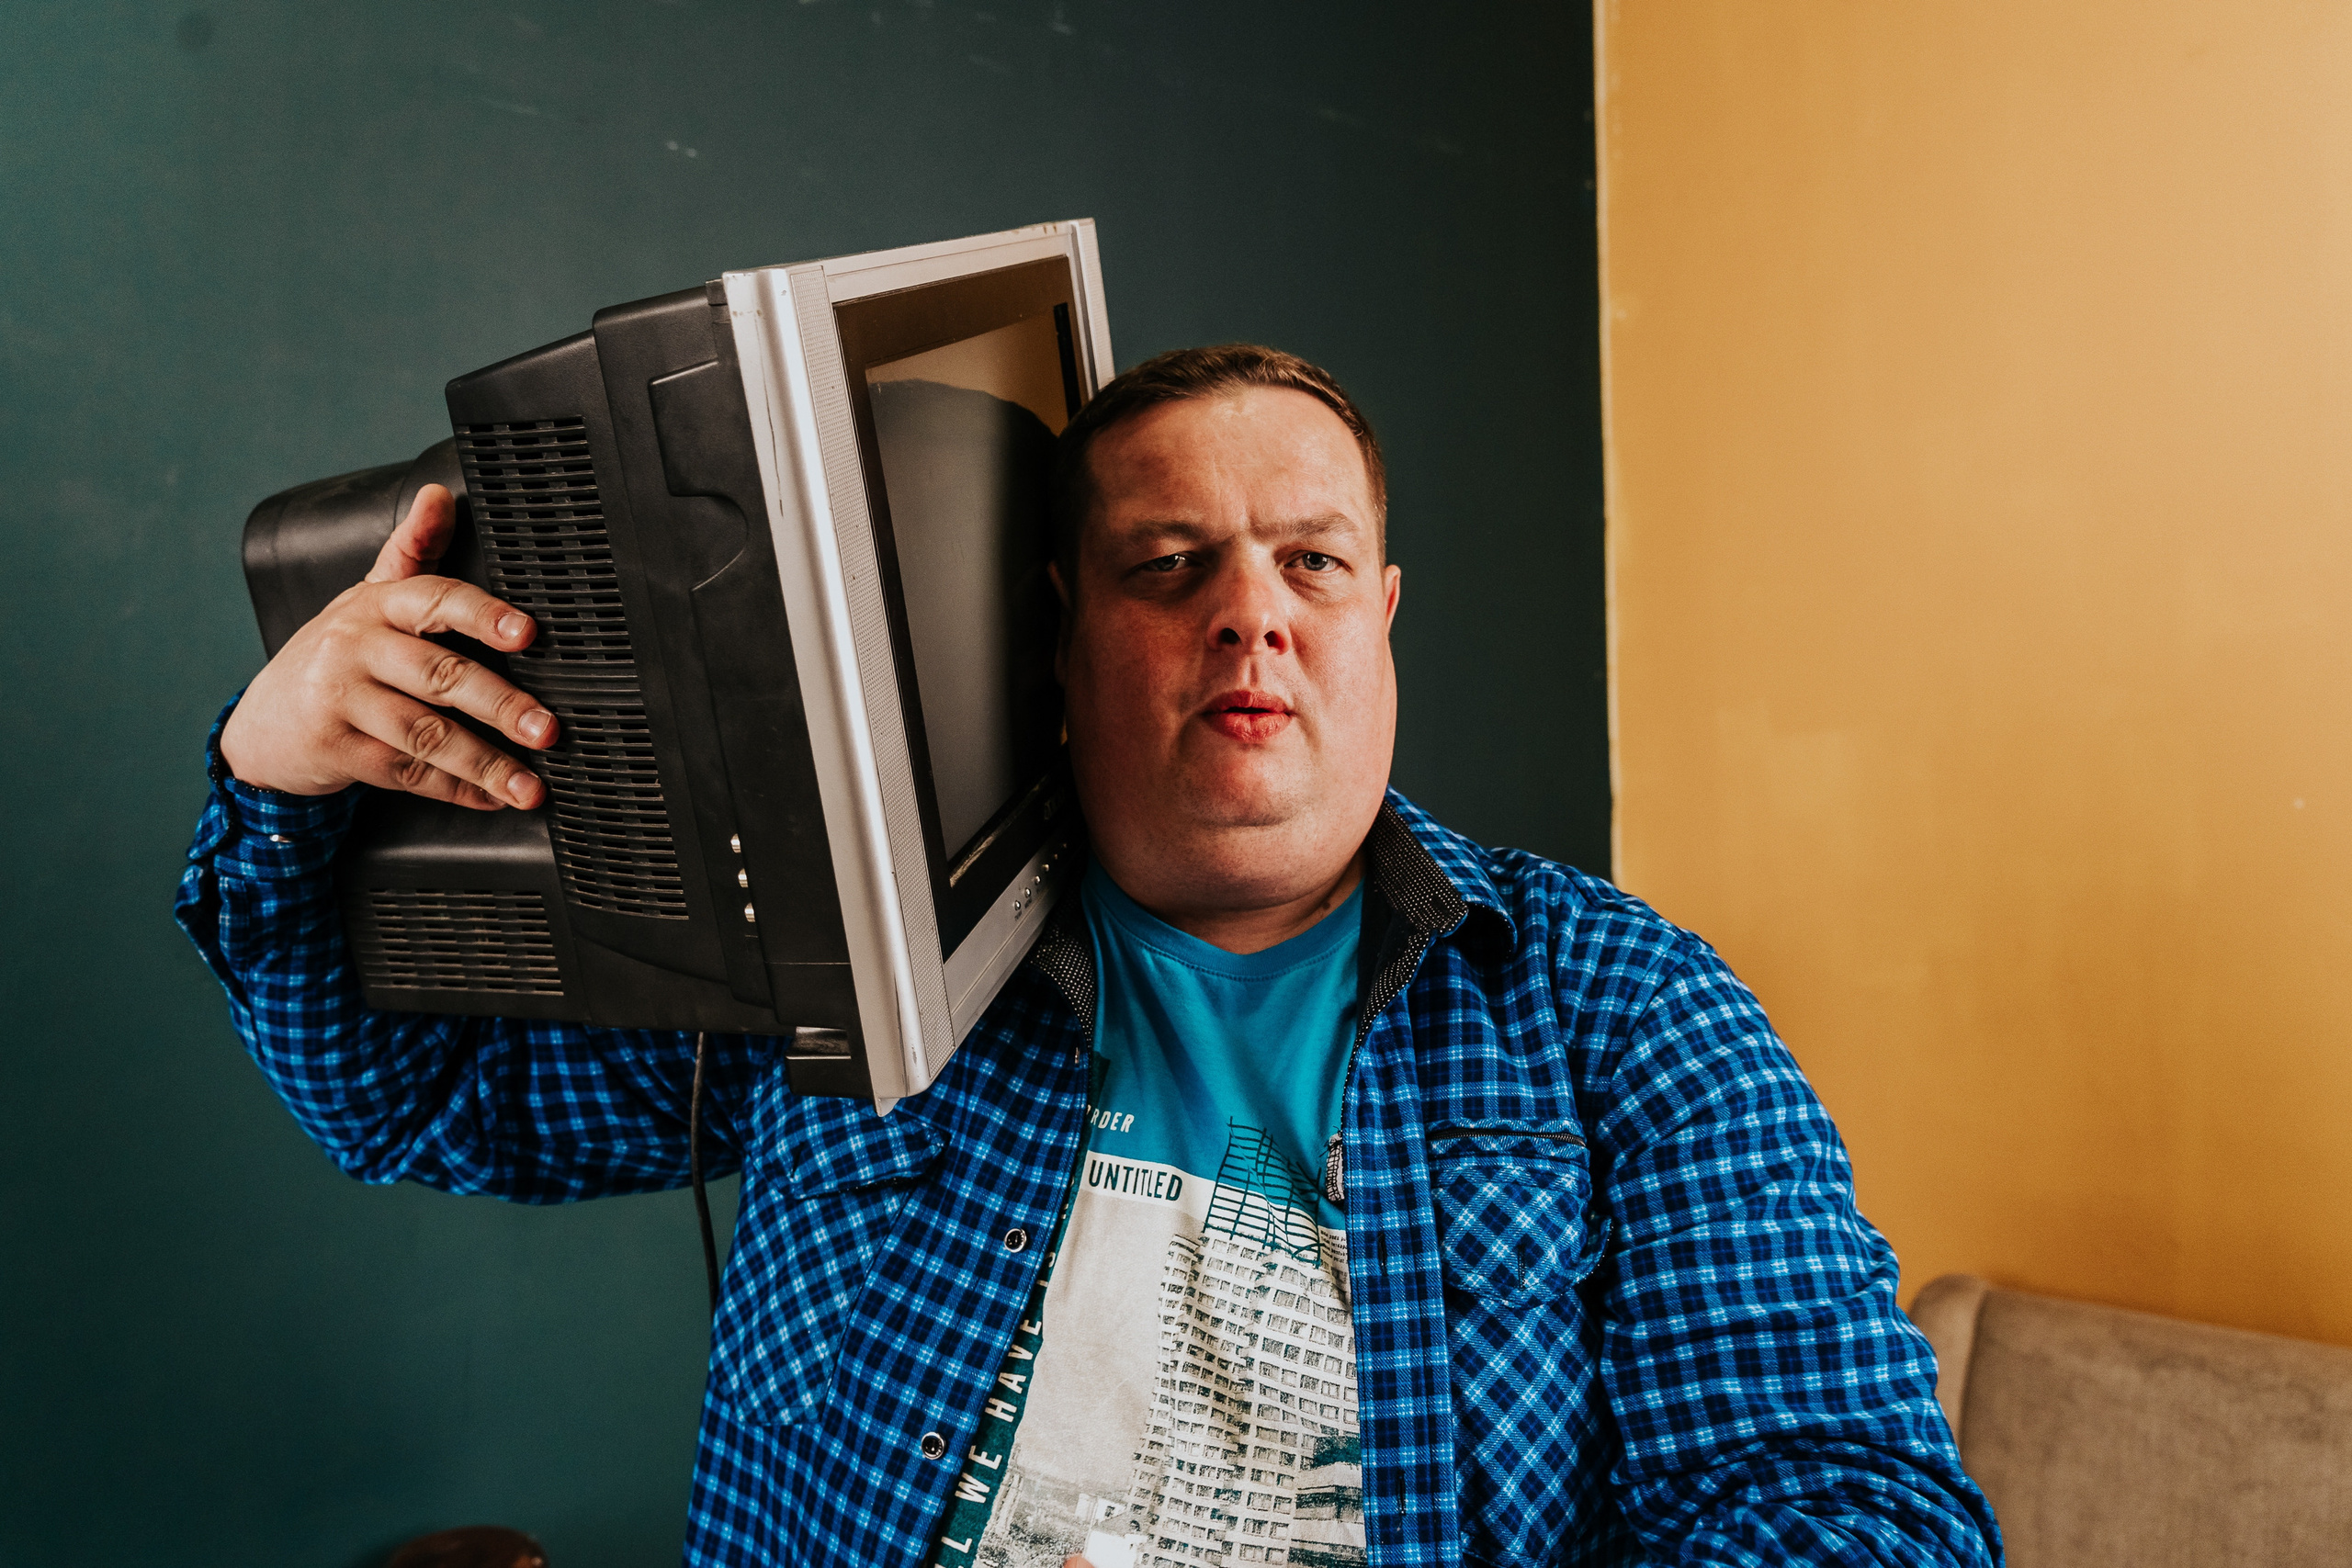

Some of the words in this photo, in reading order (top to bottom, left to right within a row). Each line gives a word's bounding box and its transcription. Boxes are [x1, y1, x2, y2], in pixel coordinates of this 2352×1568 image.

[1086, 1104, 1135, 1133] RDER
[1089, 1159, 1183, 1201] UNTITLED
[956, 1445, 1002, 1504] WE
[985, 1319, 1043, 1422] HAVE
